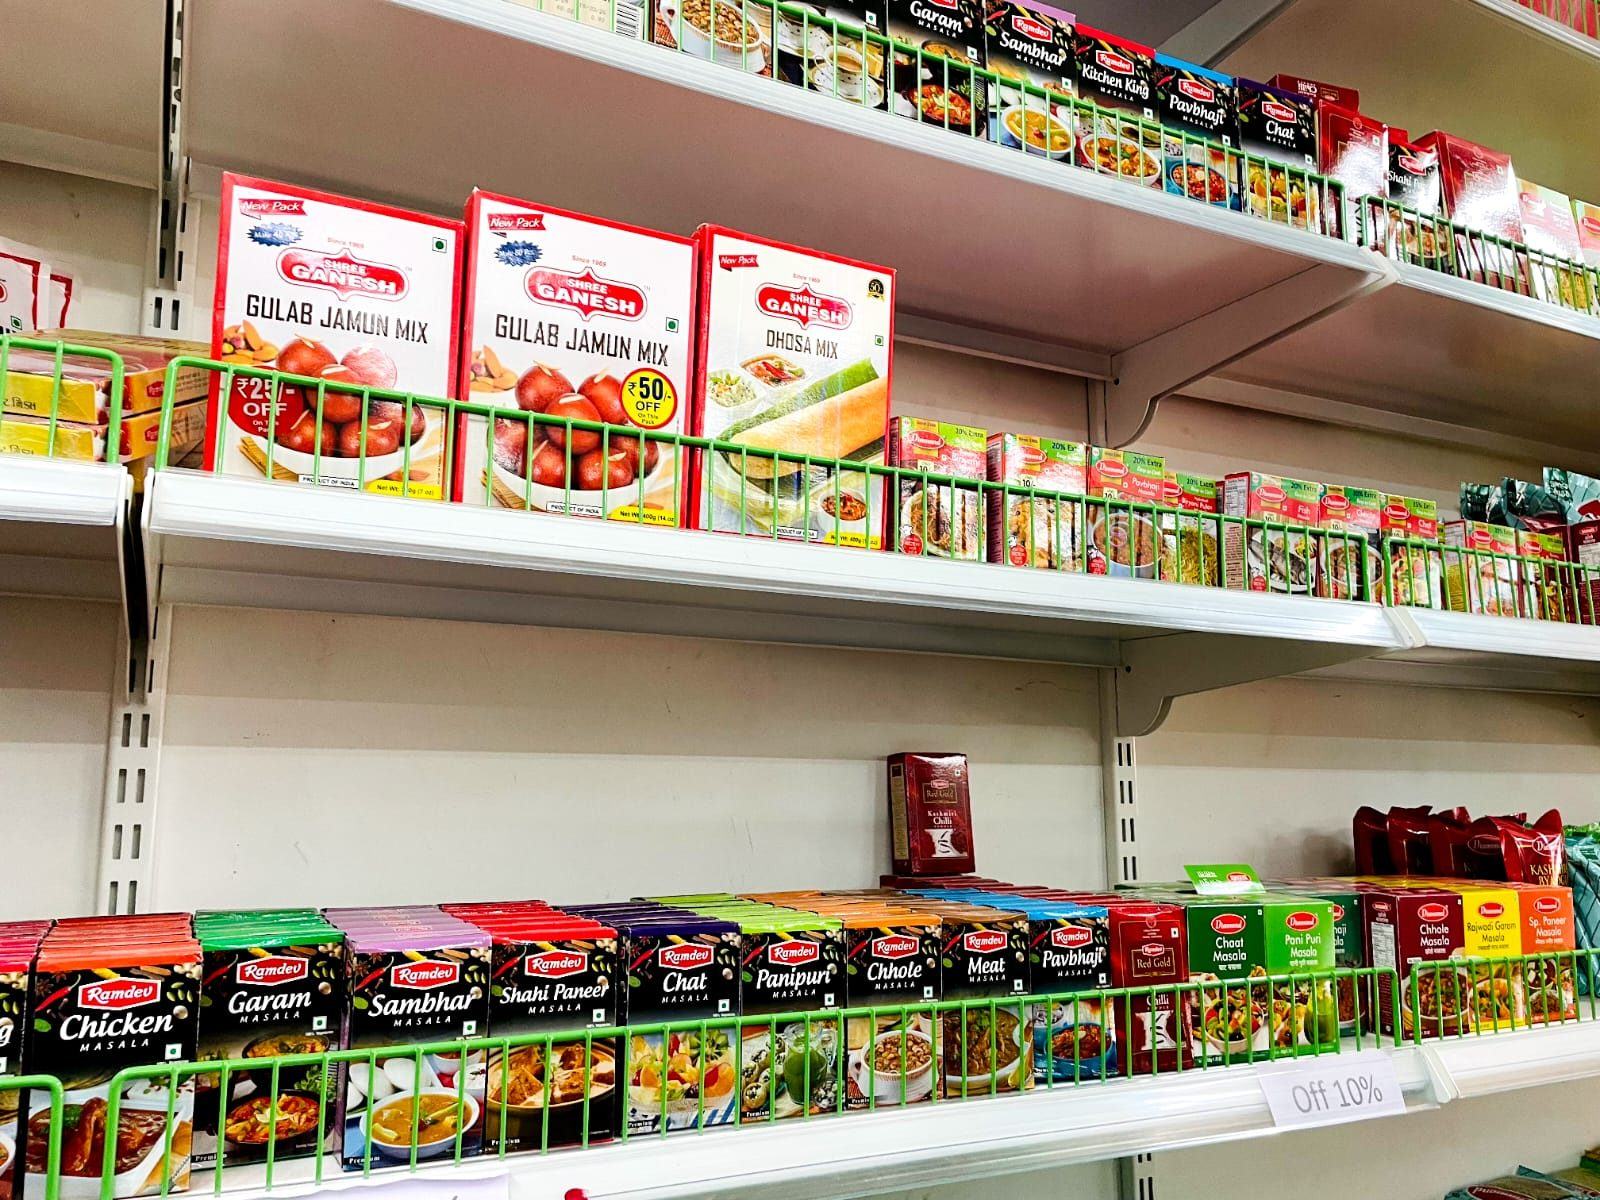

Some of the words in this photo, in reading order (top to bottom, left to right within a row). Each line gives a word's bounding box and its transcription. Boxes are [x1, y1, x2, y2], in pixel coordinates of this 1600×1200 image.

[910, 1, 963, 32] Garam
[918, 20, 957, 38] MASALA
[1015, 18, 1049, 37] Ramdev
[1000, 28, 1067, 67] Sambhar
[1015, 54, 1052, 71] MASALA
[1099, 53, 1132, 72] Ramdev
[1082, 63, 1122, 88] Kitchen
[1125, 77, 1149, 100] King
[1100, 86, 1134, 102] MASALA
[1181, 81, 1213, 99] Ramdev
[1170, 94, 1225, 125] Pavbhaji
[1182, 116, 1214, 130] MASALA
[1266, 120, 1296, 140] Chat
[1387, 170, 1412, 186] Shahi
[242, 201, 268, 210] New
[272, 202, 300, 212] Pack
[490, 218, 513, 228] New
[516, 218, 540, 228] Pack
[325, 258, 367, 275] SHREE
[721, 256, 737, 265] New
[738, 256, 756, 265] Pack
[290, 264, 396, 295] GANESH
[566, 278, 608, 294] SHREE
[537, 284, 636, 315] GANESH
[790, 292, 822, 306] SHREE
[766, 298, 844, 324] GANESH
[246, 294, 312, 325] GULAB
[320, 306, 390, 336] JAMUN
[395, 318, 429, 344] MIX
[495, 314, 559, 348] GULAB
[566, 328, 630, 361] JAMUN
[638, 340, 669, 367] MIX
[766, 330, 812, 355] DHOSA
[816, 338, 839, 360] MIX
[243, 402, 288, 416] OFF
[636, 400, 660, 412] OFF
[1052, 442, 1066, 451] 20%
[1132, 456, 1146, 465] 20%
[1146, 460, 1162, 468] Extra
[302, 476, 326, 484] PROUCT
[1132, 476, 1160, 490] Pavbhaji
[1200, 481, 1214, 489] Extra
[550, 504, 576, 512] PRODCT
[933, 816, 952, 825] Chilli
[1420, 922, 1450, 934] Chhole
[1466, 921, 1494, 933] Rajwadi
[1494, 920, 1516, 930] Garam
[1542, 916, 1566, 926] Paneer
[1056, 931, 1088, 944] Ramdev
[1284, 934, 1304, 945] Pani
[1306, 933, 1321, 944] Puri
[1482, 932, 1504, 942] Masala
[1536, 928, 1562, 937] Masala
[877, 941, 914, 954] Ramdev
[968, 936, 1003, 949] Ramdev
[1216, 936, 1244, 948] Chaat
[1420, 935, 1450, 946] Masala
[664, 950, 708, 965] Ramdev
[774, 947, 814, 962] Ramdev
[1042, 946, 1104, 969] Pavbhaji
[1213, 949, 1246, 962] Masala
[1290, 946, 1317, 957] Masala
[532, 956, 581, 972] Ramdev
[968, 956, 1006, 976] Meat
[1137, 958, 1152, 968] Red
[1154, 956, 1171, 968] Gold
[244, 963, 302, 980] Ramdev
[399, 968, 453, 983] Ramdev
[867, 961, 922, 981] Chhole
[1057, 968, 1092, 978] MASALA
[662, 972, 708, 993] Chat
[756, 968, 831, 992] Panipuri
[874, 981, 915, 990] MASALA
[969, 974, 1006, 983] MASALA
[86, 985, 153, 1005] Ramdev
[500, 984, 550, 1004] Shahi
[553, 983, 610, 1001] Paneer
[662, 994, 708, 1004] MASALA
[772, 988, 816, 998] MASALA
[1146, 994, 1170, 1006] Cilli
[228, 990, 312, 1015] Garam
[368, 992, 476, 1017] Sambhar
[528, 1004, 581, 1014] MASALA
[240, 1012, 300, 1024] MASALA
[394, 1016, 451, 1027] MASALA
[60, 1012, 174, 1041] Chicken
[80, 1039, 150, 1052] MASALA
[1292, 1080, 1330, 1114] Off
[1332, 1072, 1383, 1108] 10%
[349, 1154, 380, 1164] Premum
